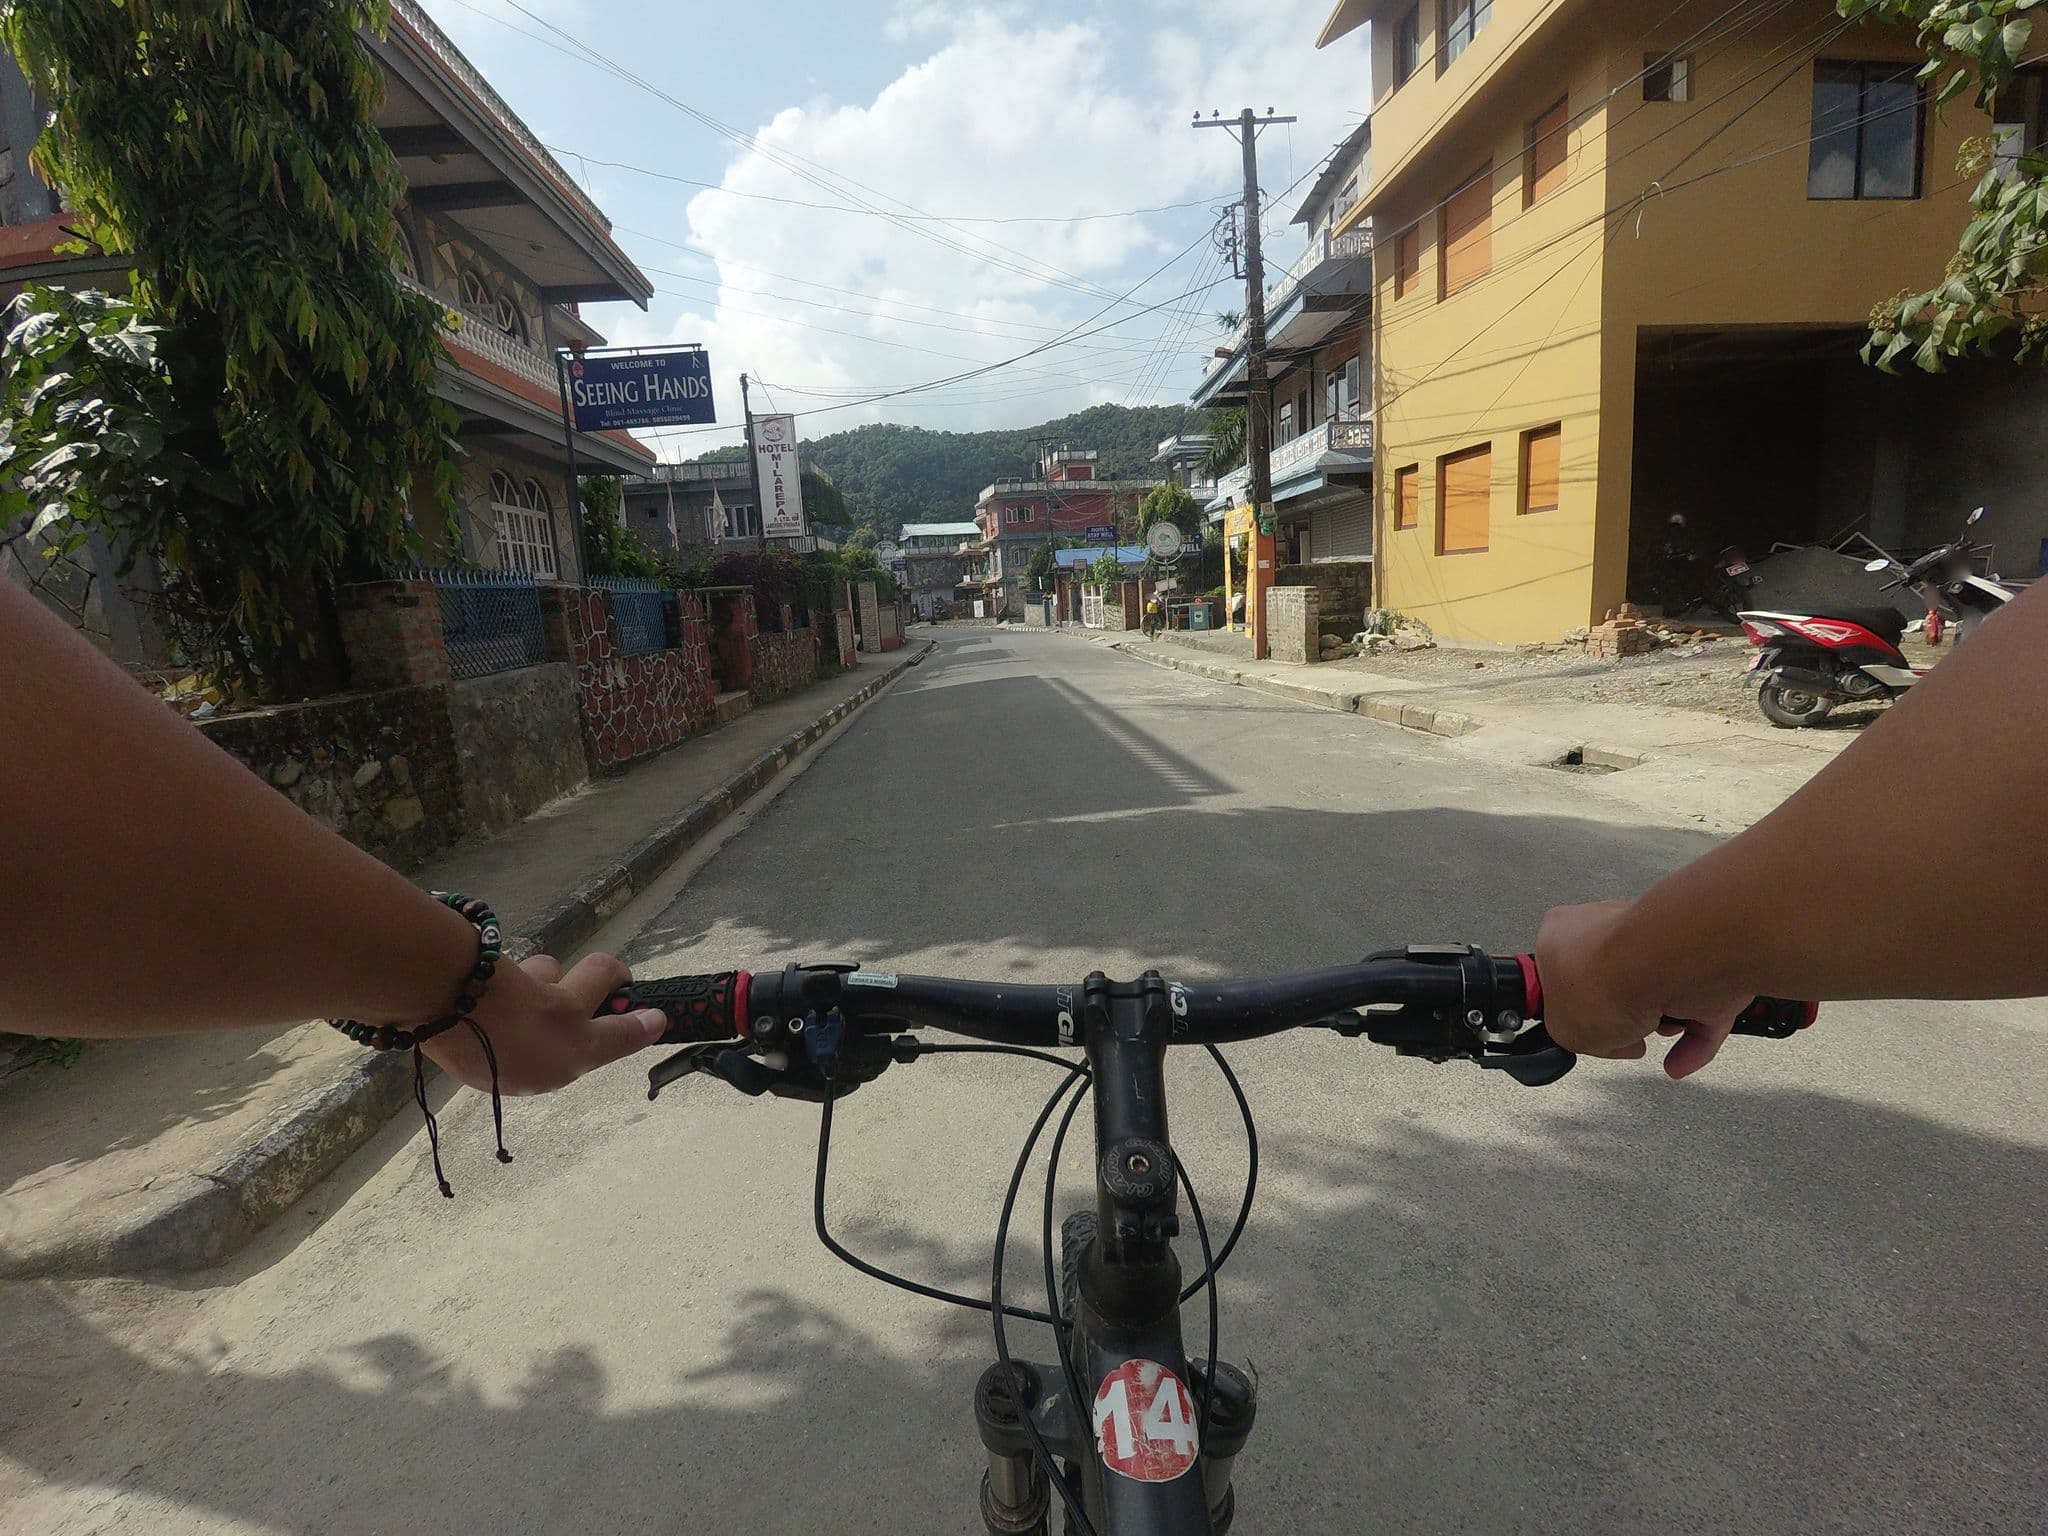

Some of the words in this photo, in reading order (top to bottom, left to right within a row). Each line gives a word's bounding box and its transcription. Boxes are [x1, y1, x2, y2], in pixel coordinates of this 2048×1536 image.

[610, 360, 653, 370] WELCOME
[655, 359, 666, 368] TO
[574, 379, 639, 407] SEEING
[643, 373, 709, 401] HANDS
[605, 409, 625, 417] Blind
[628, 407, 660, 416] Massage
[661, 405, 682, 413] Clinic
[759, 444, 793, 453] HOTEL
[771, 454, 786, 516] MILAREPA
[1097, 1377, 1193, 1460] 14
